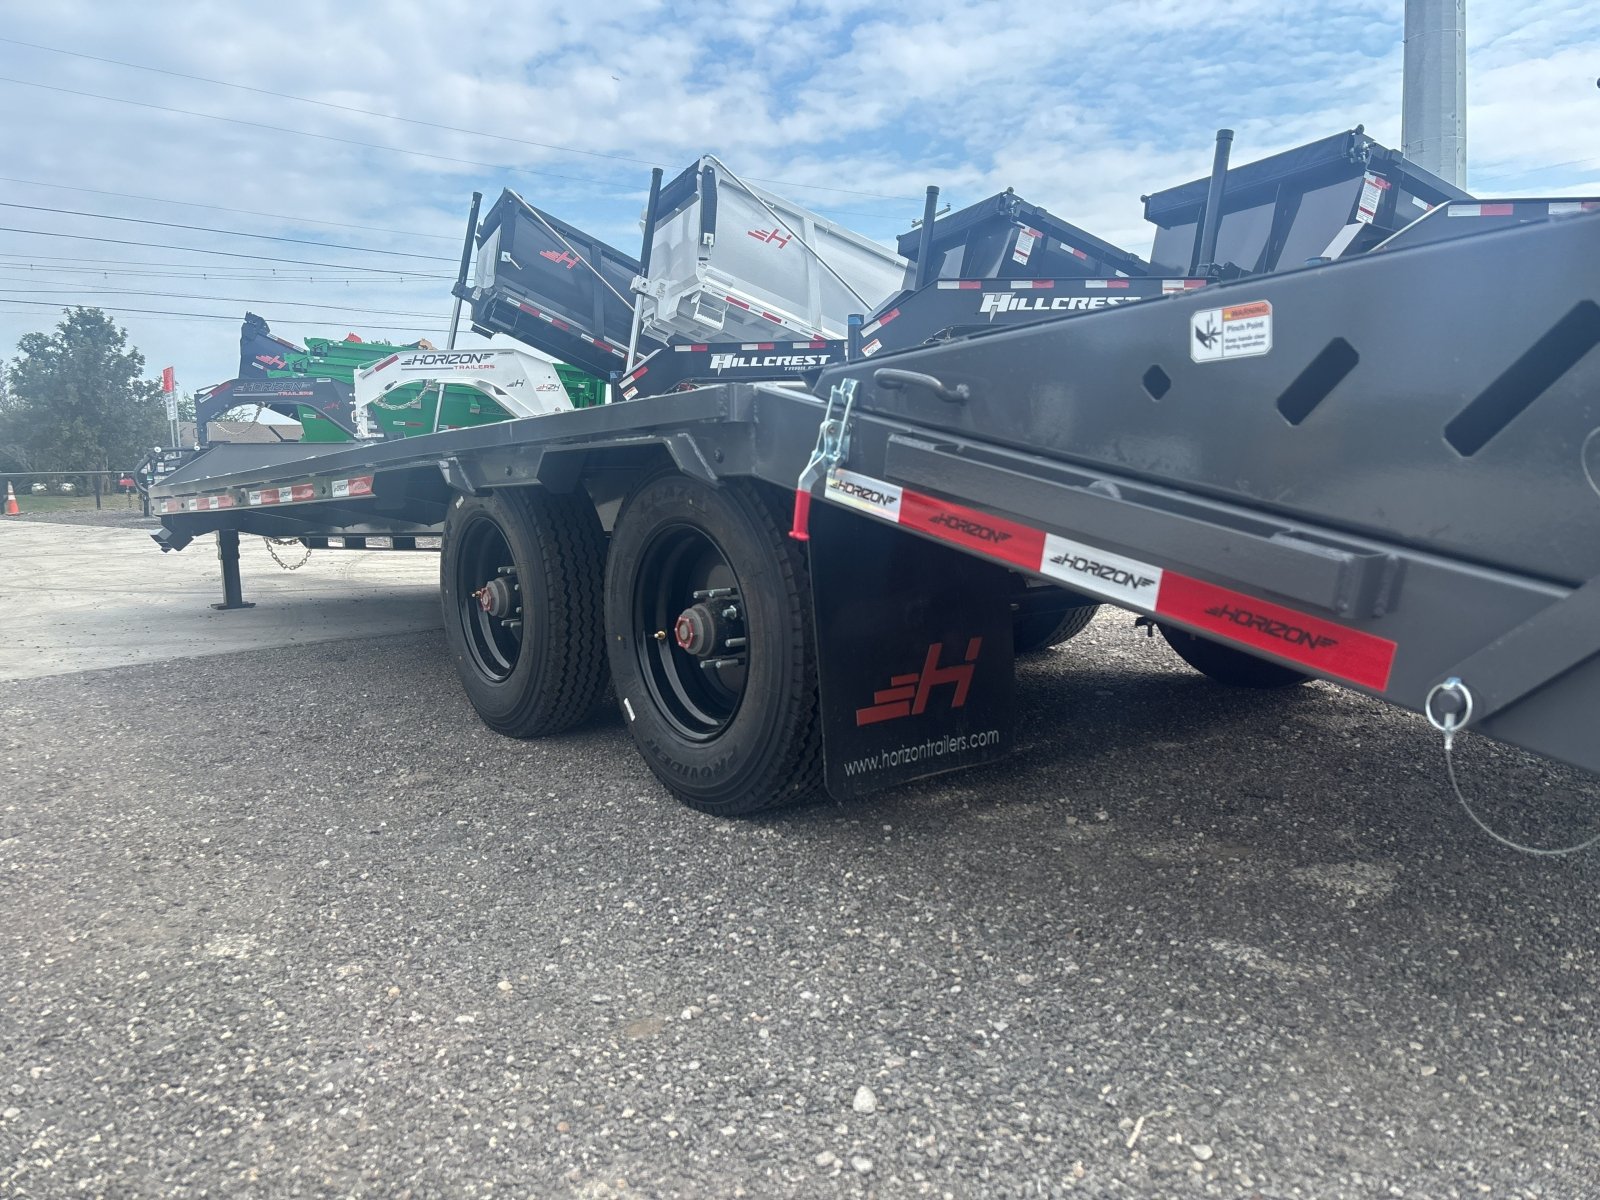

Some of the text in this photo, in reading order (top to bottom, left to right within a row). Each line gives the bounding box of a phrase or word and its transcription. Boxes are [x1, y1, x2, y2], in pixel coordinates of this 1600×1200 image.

[1226, 324, 1245, 332] Pinch
[411, 353, 484, 366] HORIZON
[709, 353, 831, 370] HILLCREST
[243, 381, 303, 392] HORIZON
[838, 480, 889, 506] HORIZON
[938, 512, 1002, 543] HORIZON
[1061, 553, 1143, 589] HORIZON
[1219, 604, 1321, 650] HORIZON
[843, 729, 1000, 777] www.horizontrailers.com
